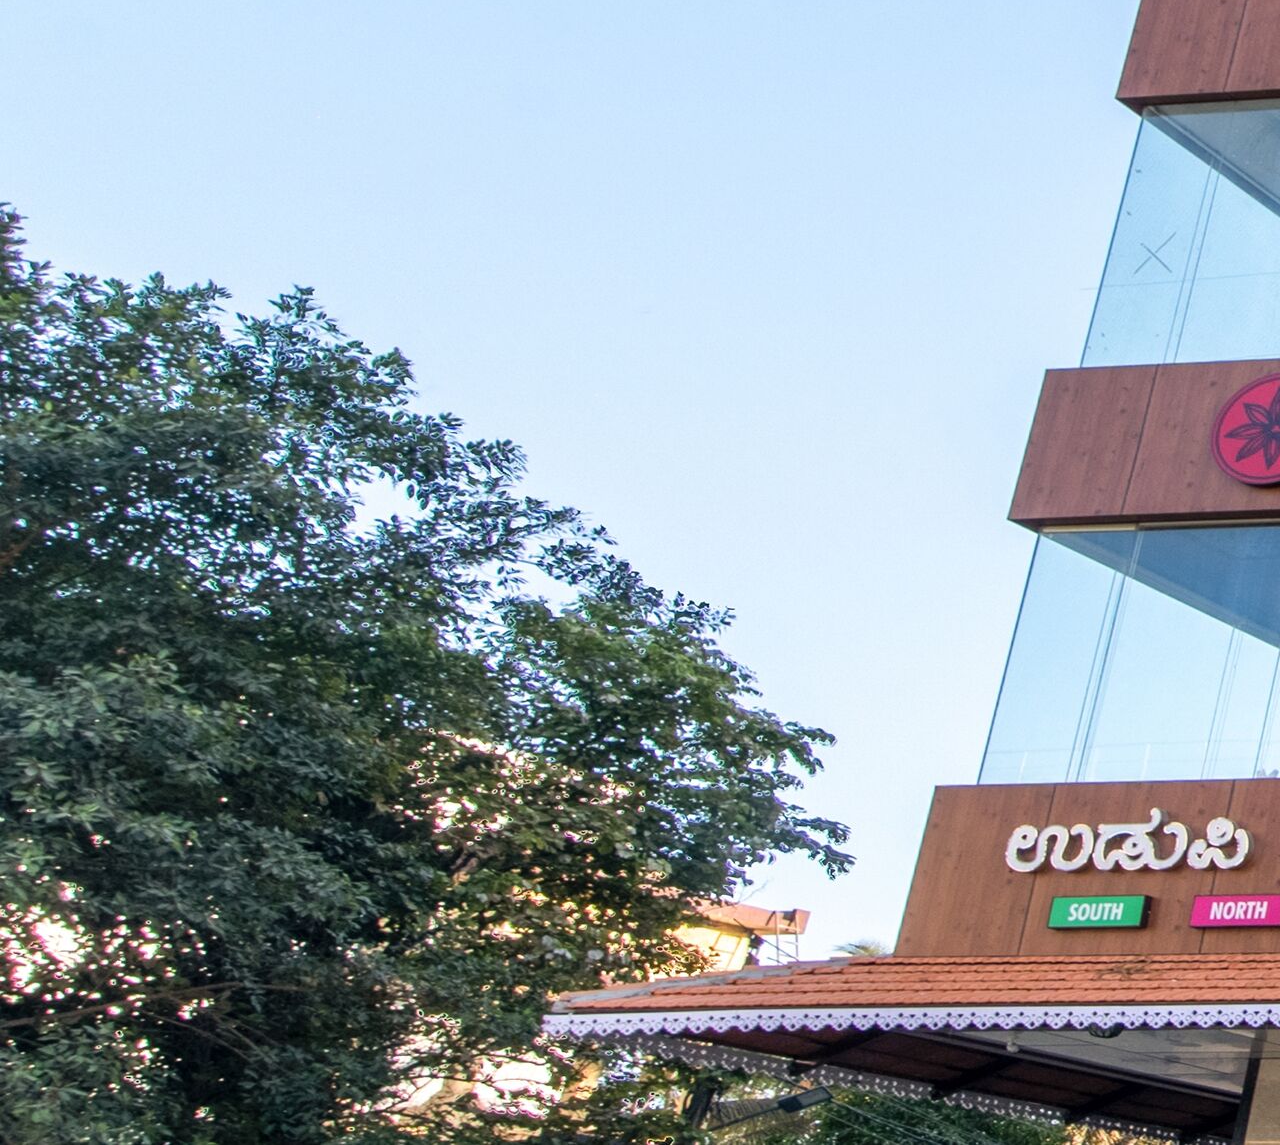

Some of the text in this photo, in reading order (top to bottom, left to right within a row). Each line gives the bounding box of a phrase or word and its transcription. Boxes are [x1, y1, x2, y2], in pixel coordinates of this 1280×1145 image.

[1004, 807, 1252, 873] ಉಡುಪಿ
[1067, 901, 1125, 922] SOUTH
[1208, 900, 1268, 921] NORTH
